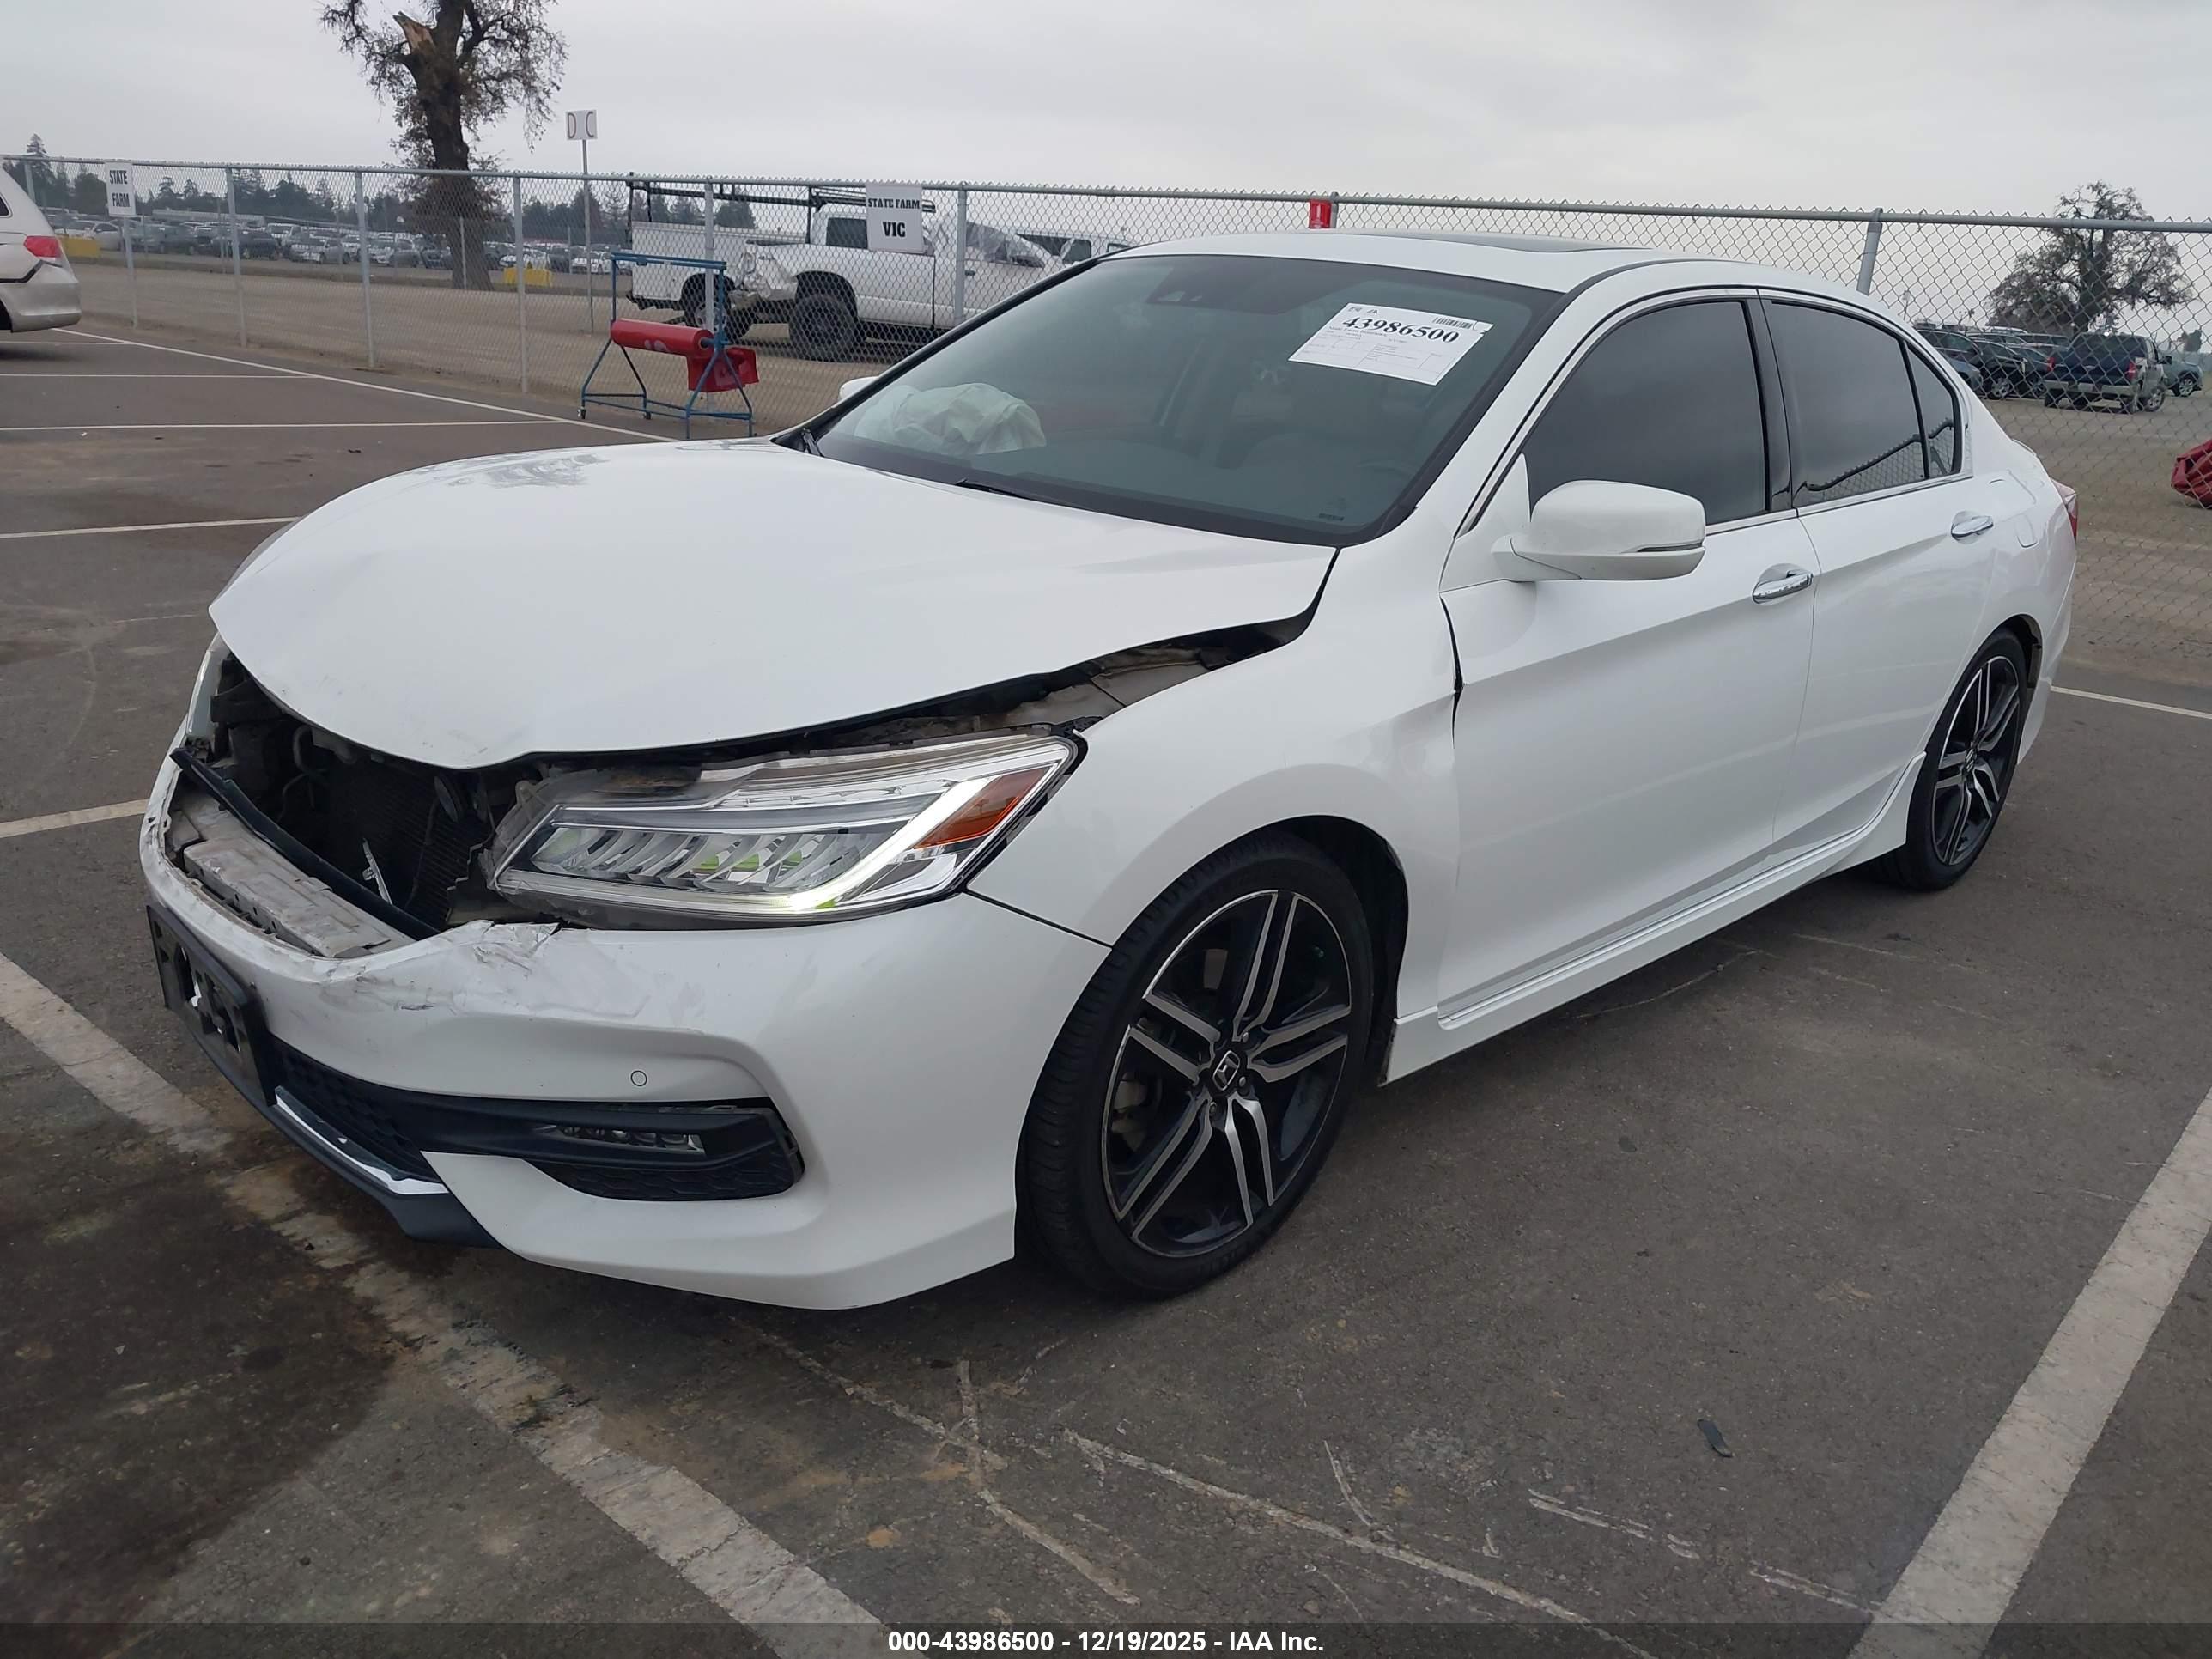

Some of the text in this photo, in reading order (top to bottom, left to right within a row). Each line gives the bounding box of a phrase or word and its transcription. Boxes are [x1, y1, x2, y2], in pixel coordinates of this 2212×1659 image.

[109, 169, 128, 185] STATE
[112, 192, 131, 208] FARM
[867, 198, 921, 210] STATE FARM
[882, 221, 906, 238] VIC
[1342, 317, 1460, 343] 43986500
